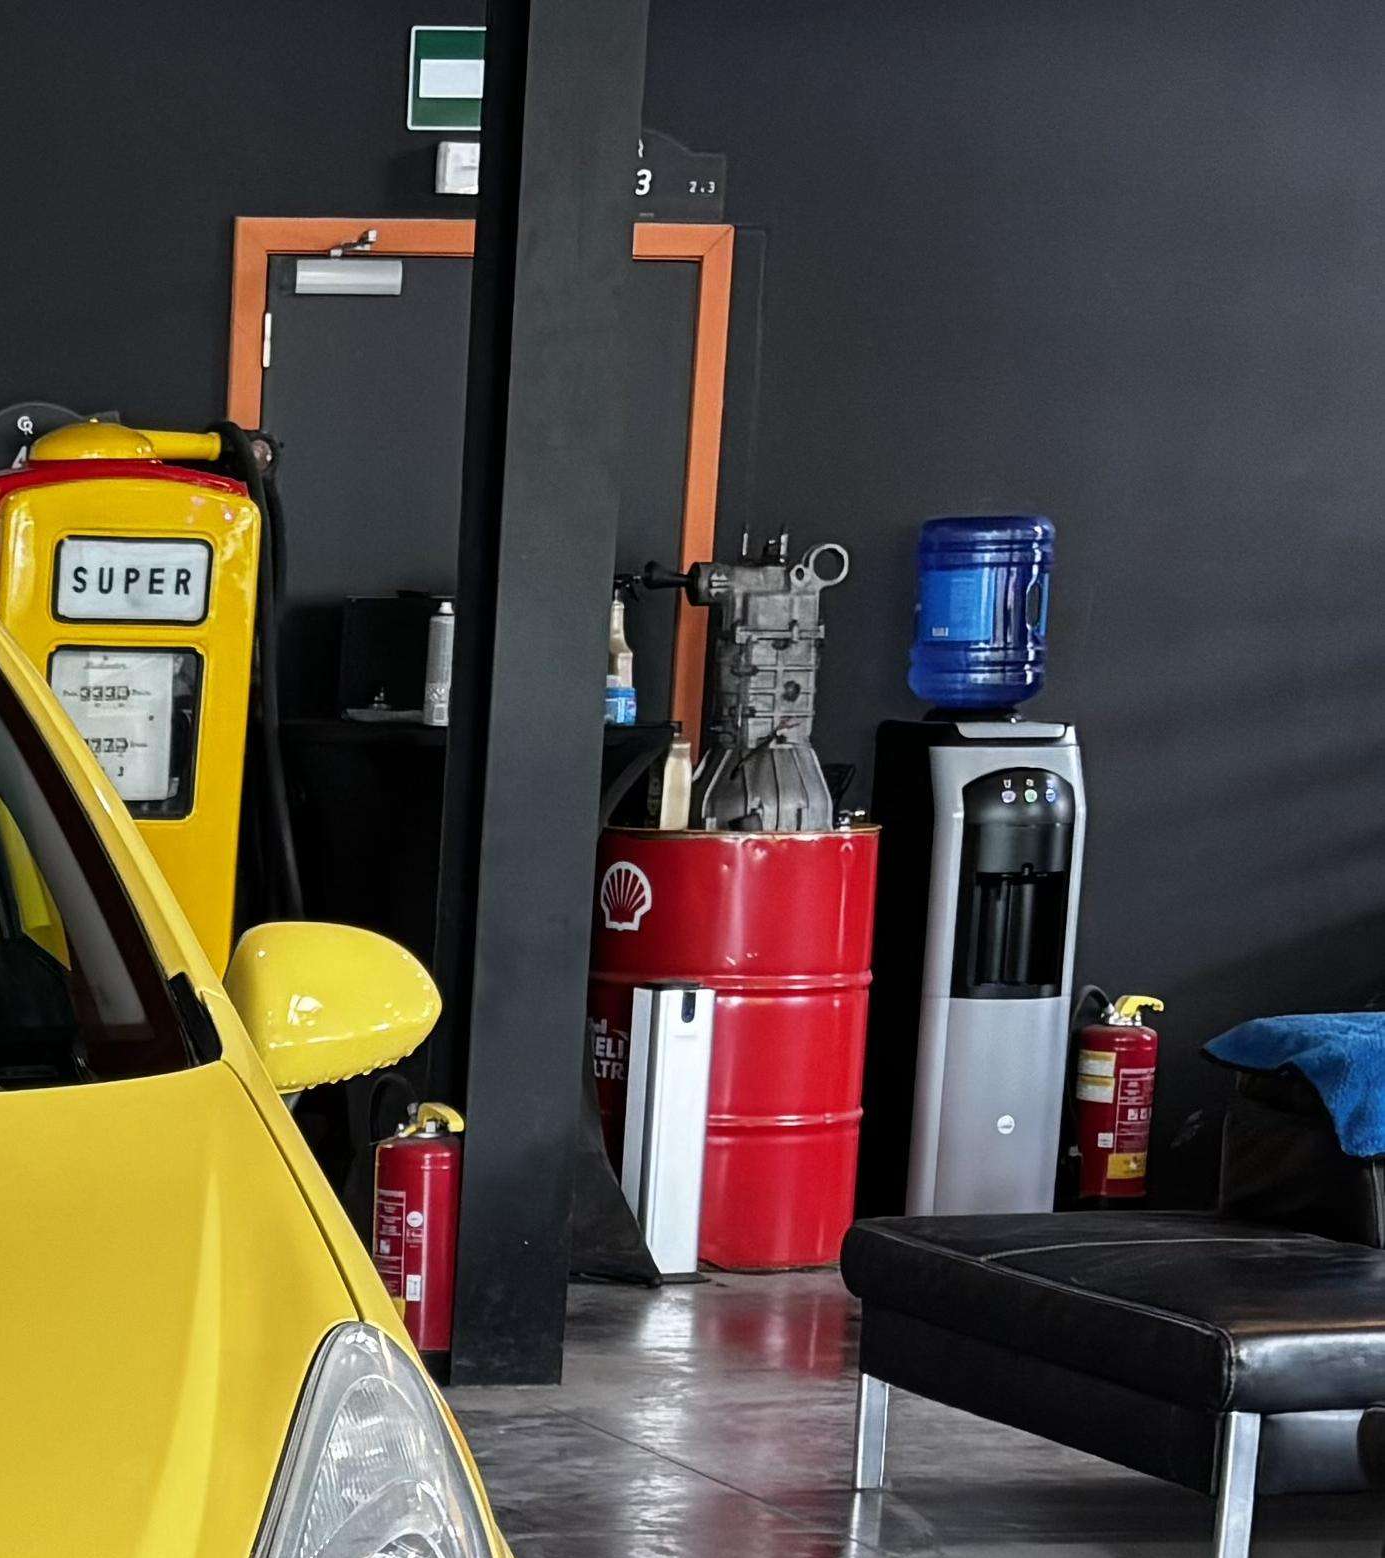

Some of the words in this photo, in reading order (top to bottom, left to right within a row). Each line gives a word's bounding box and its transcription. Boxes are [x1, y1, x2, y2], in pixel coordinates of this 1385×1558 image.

[72, 566, 191, 595] SUPER
[592, 1035, 625, 1060] ELI
[593, 1059, 625, 1080] LTR
